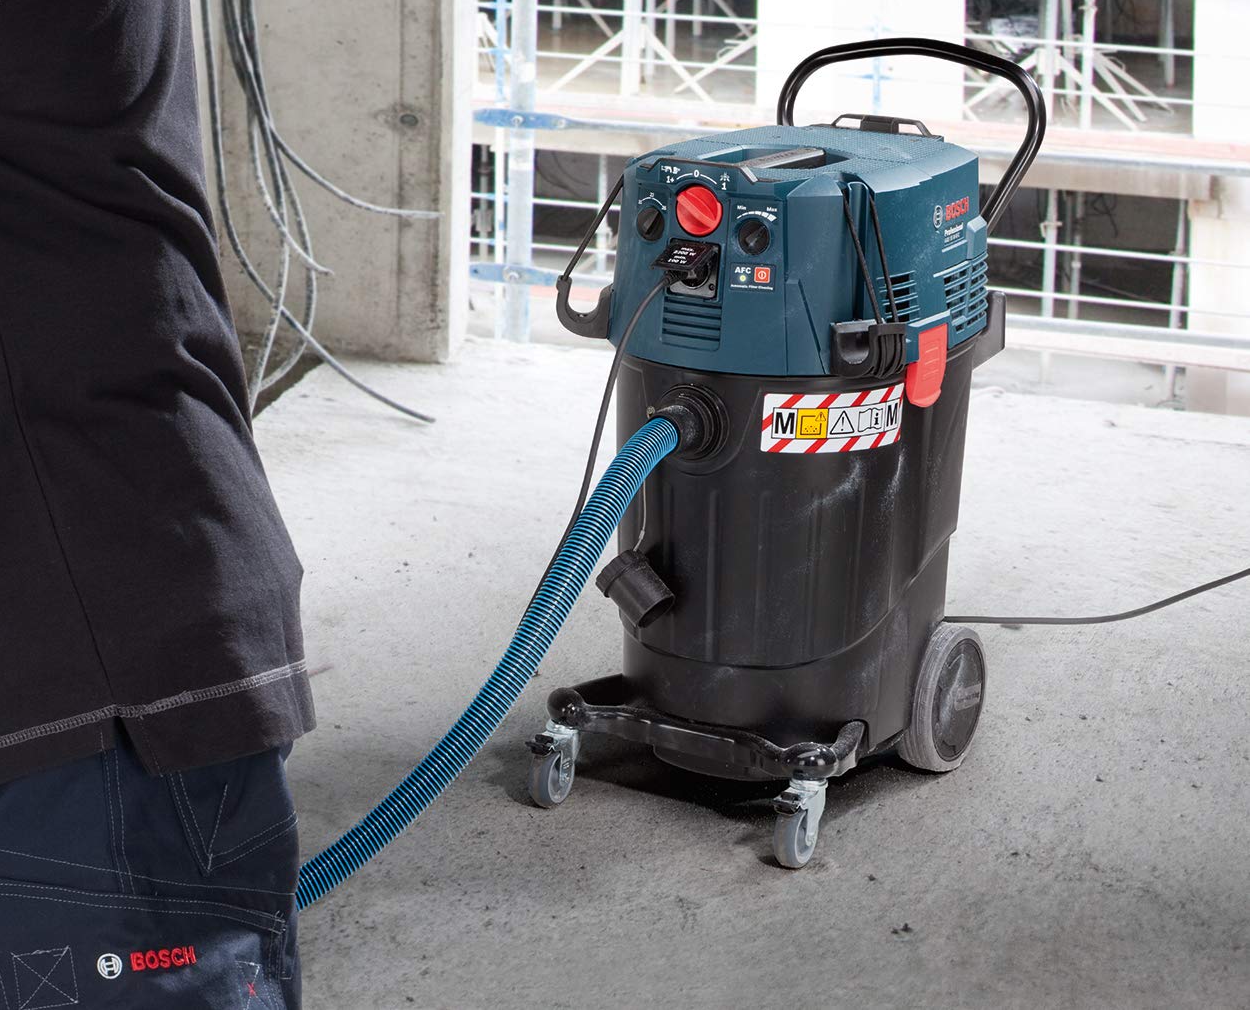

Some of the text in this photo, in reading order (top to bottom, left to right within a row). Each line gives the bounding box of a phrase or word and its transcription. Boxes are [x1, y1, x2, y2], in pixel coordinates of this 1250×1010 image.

[945, 196, 969, 221] BOSCH
[734, 266, 752, 274] AFC
[774, 402, 899, 435] M M
[130, 946, 197, 972] BOSCH
